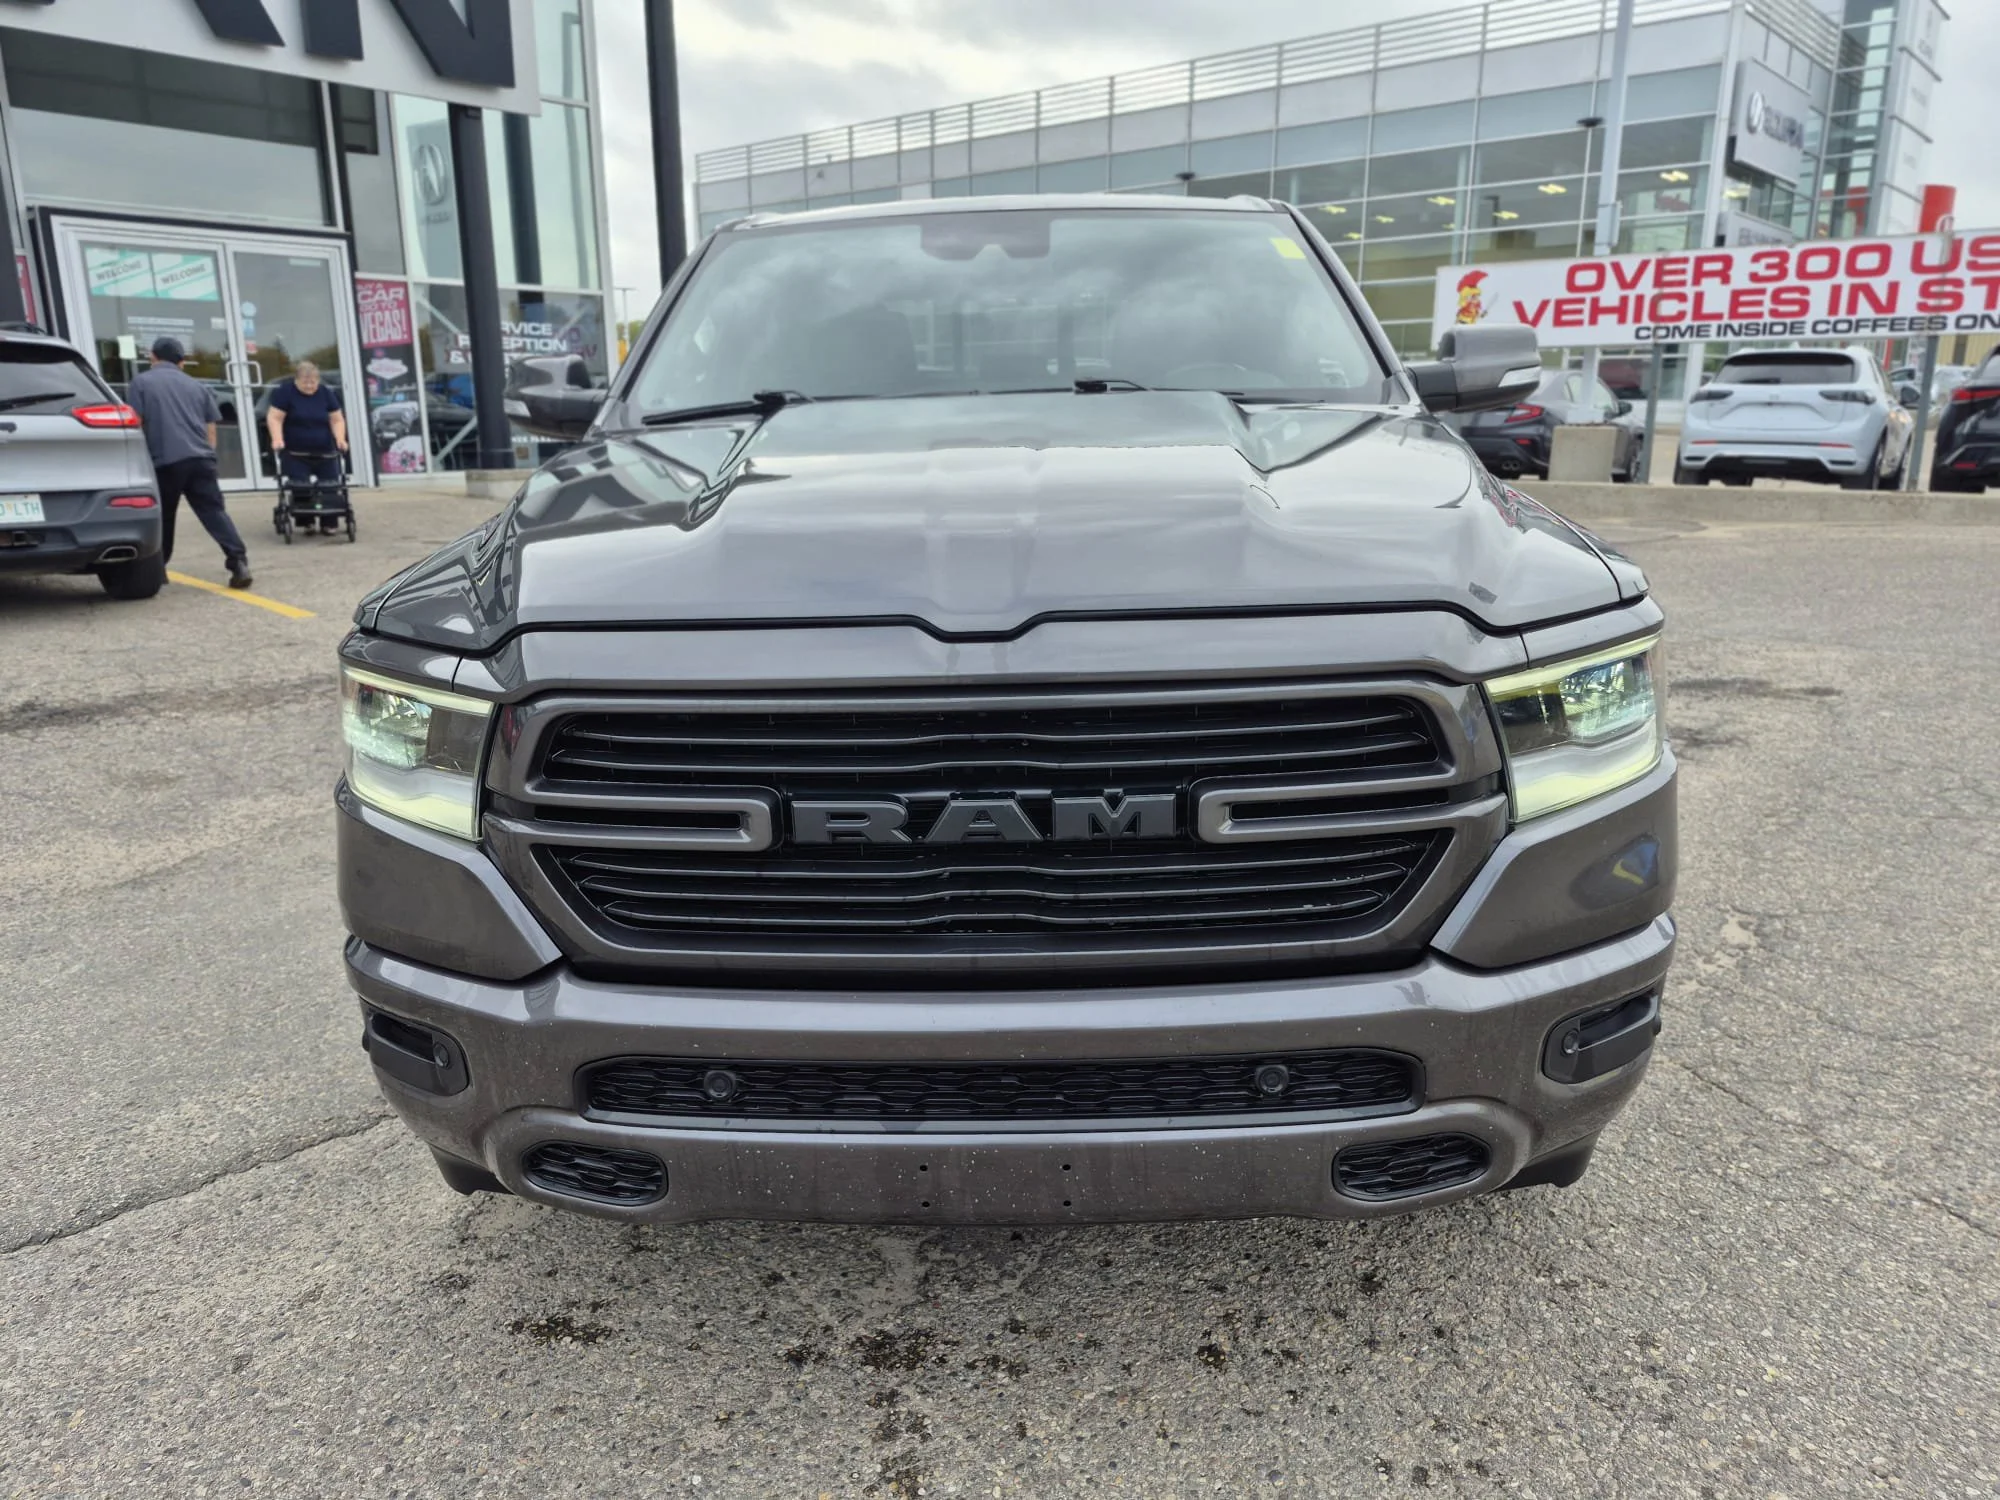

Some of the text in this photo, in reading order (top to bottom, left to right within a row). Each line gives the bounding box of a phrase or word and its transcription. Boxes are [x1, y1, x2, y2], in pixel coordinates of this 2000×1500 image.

[96, 260, 142, 281] WELCOME
[161, 263, 206, 285] WELCOME
[1566, 235, 2000, 294] OVER 300 US
[357, 287, 405, 305] CAR
[1512, 276, 2000, 328] VEHICLES IN ST
[360, 308, 408, 345] VEGAS!
[1634, 324, 1711, 340] COME
[1716, 320, 1806, 338] INSIDE
[1811, 315, 1948, 335] COFFEES
[457, 333, 567, 352] REPTION
[791, 793, 1177, 843] RAM
